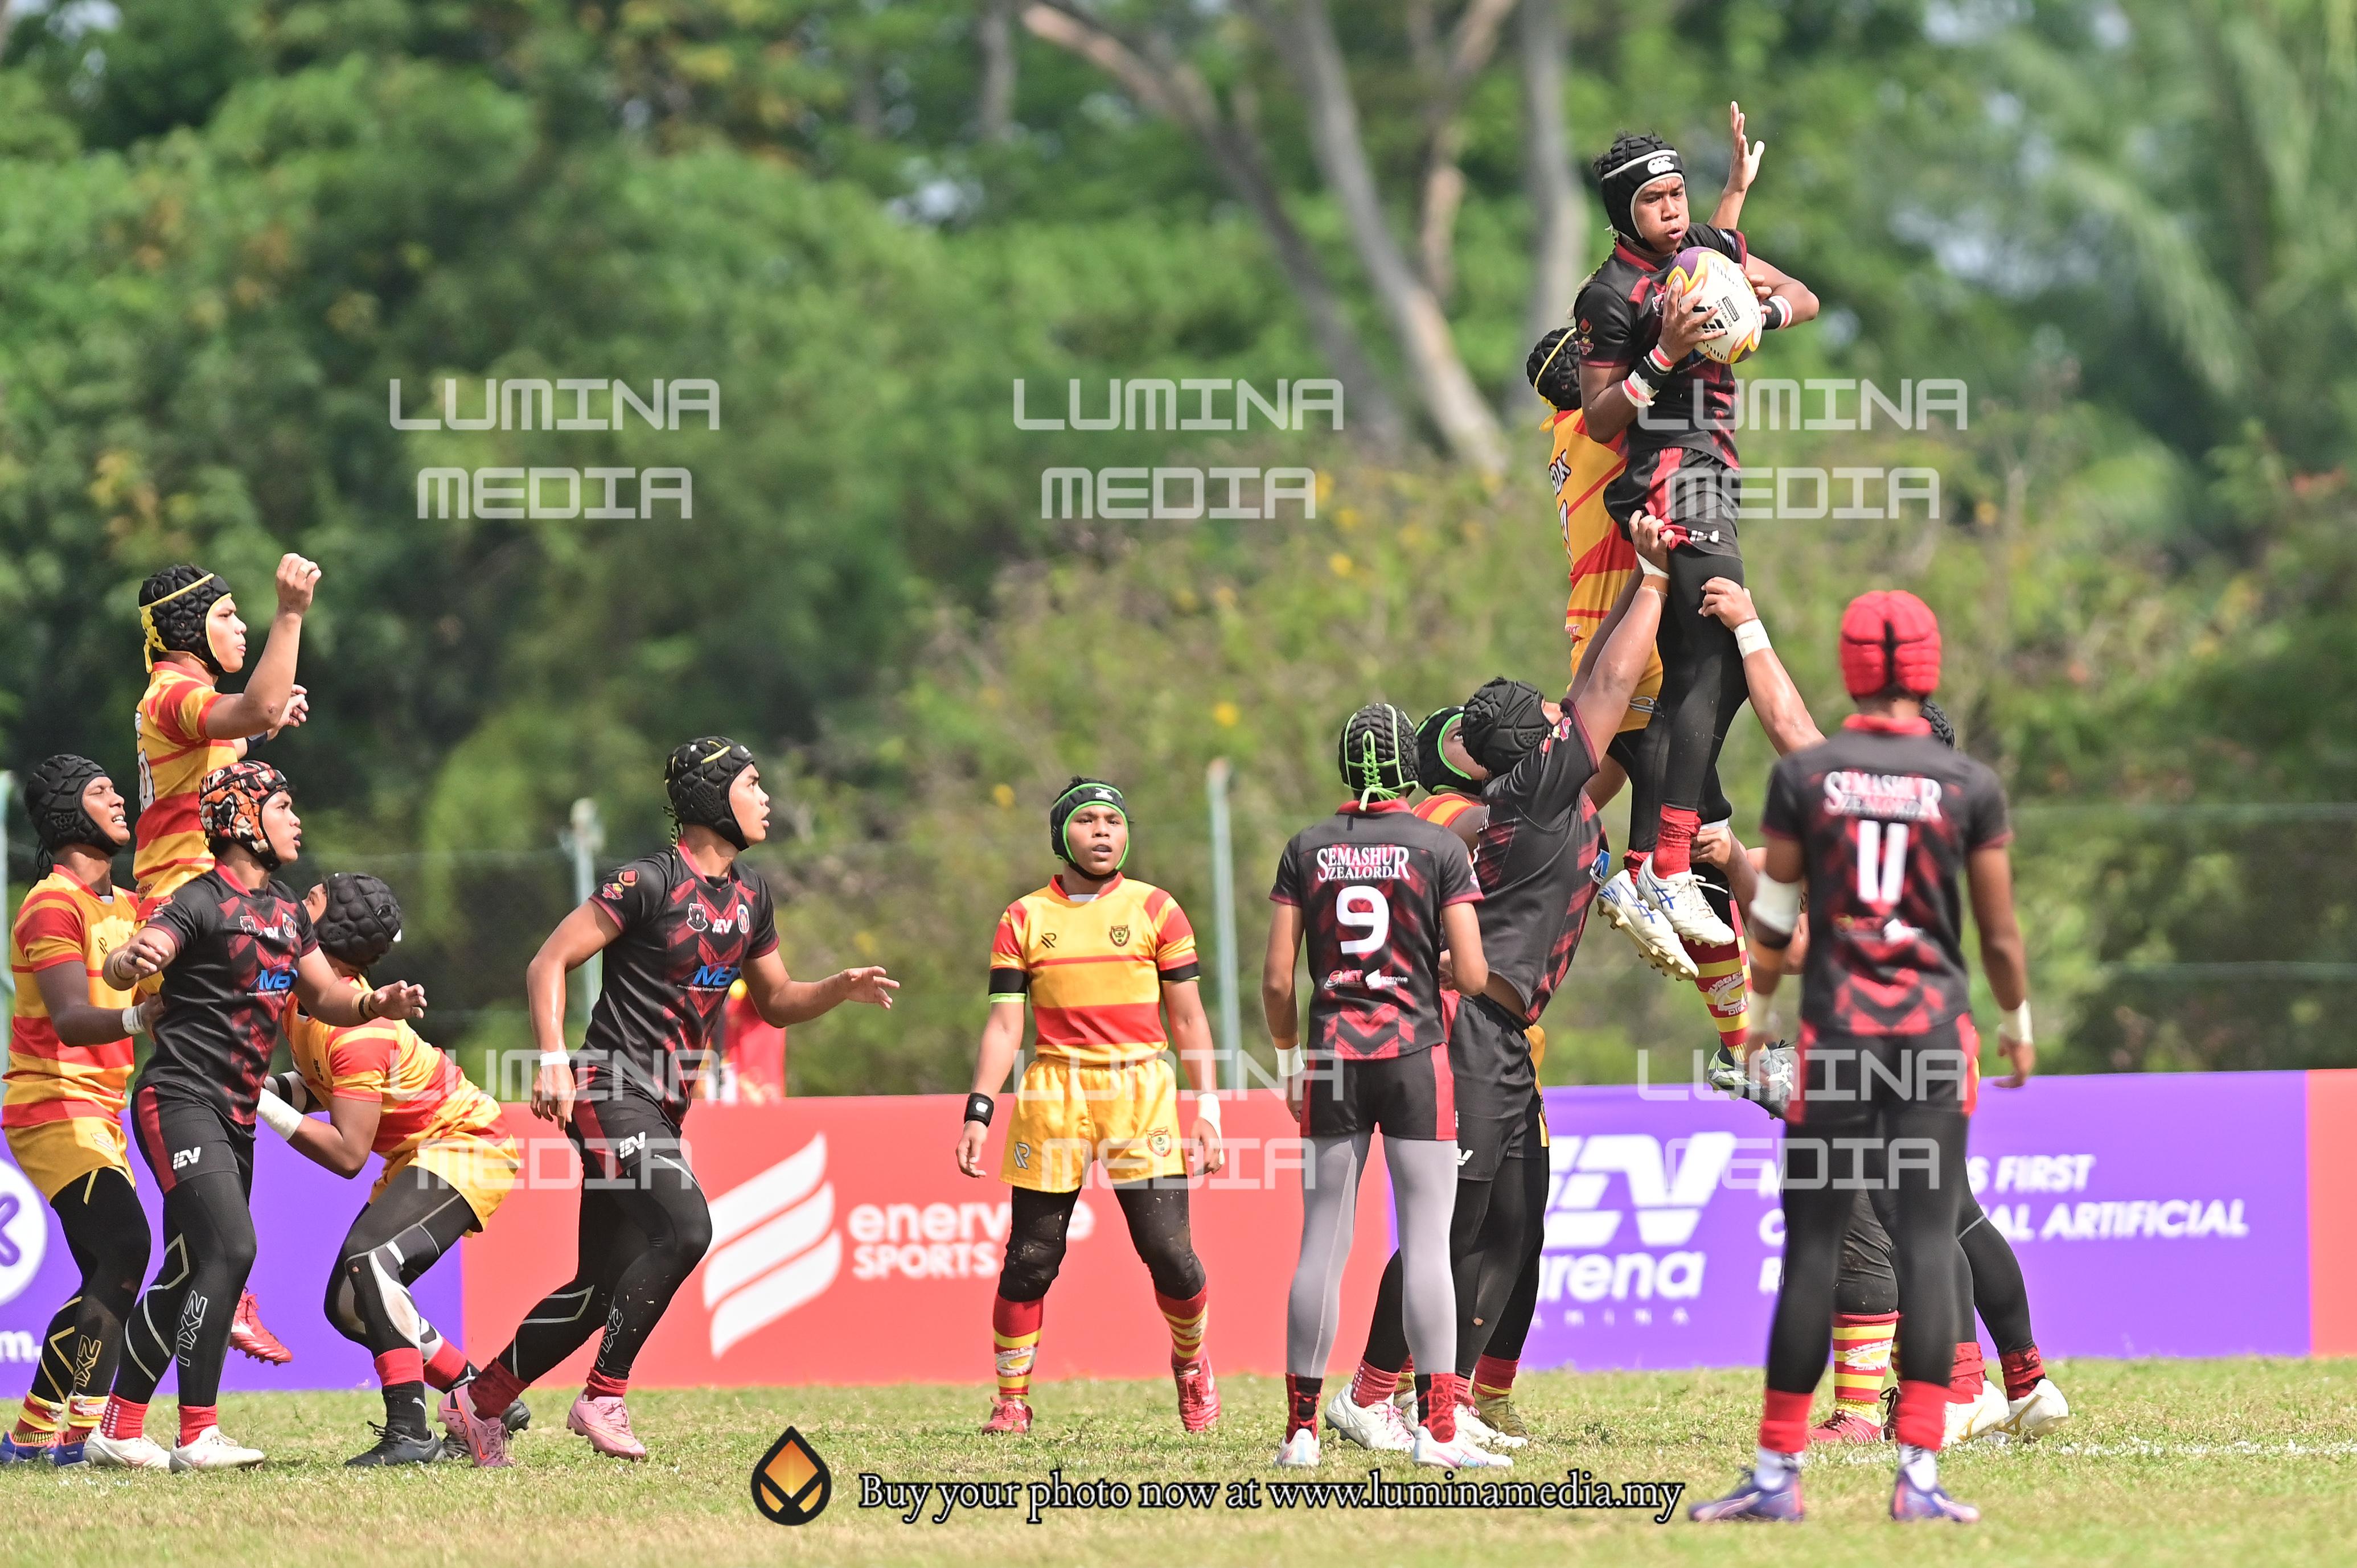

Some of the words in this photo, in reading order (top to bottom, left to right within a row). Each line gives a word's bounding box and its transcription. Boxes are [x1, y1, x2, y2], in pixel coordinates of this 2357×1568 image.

[1317, 846, 1411, 882] SEMASHUR
[1328, 866, 1393, 880] ZEALORD
[1336, 885, 1390, 954] 9
[1995, 1153, 2097, 1194] FIRST
[2039, 1197, 2251, 1242] ARTIFICIAL
[852, 1241, 999, 1281] SPORTS
[175, 1290, 208, 1367] 2XU
